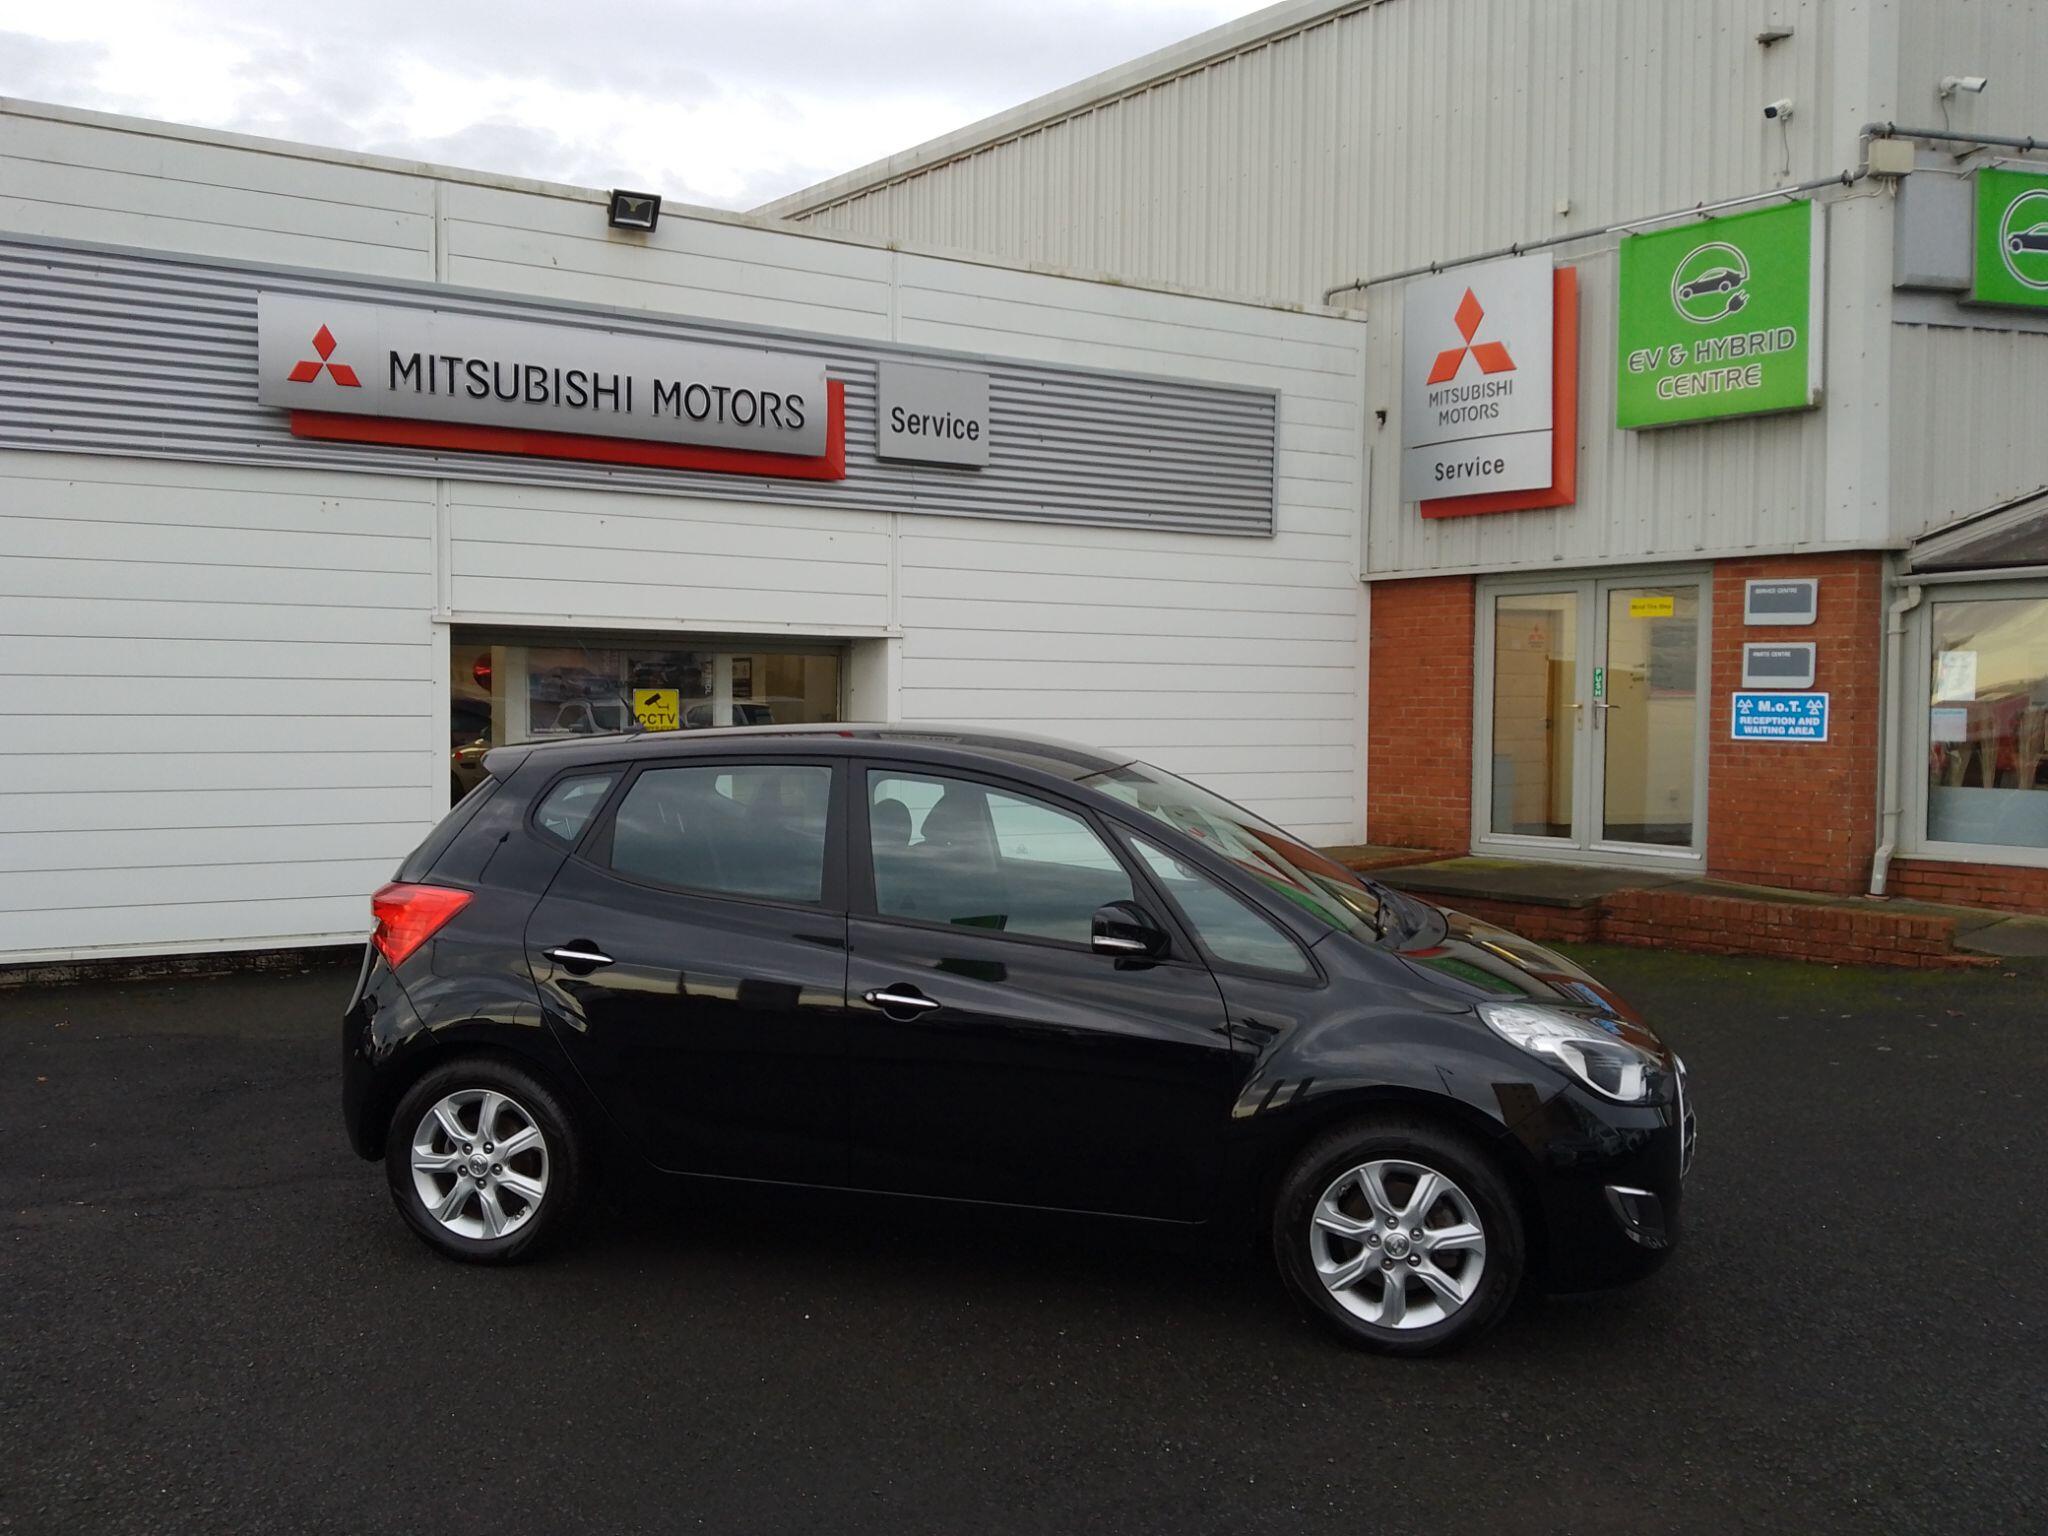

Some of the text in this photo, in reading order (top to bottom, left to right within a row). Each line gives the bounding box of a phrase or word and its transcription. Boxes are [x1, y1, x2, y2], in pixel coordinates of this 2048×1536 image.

[1628, 326, 1797, 373] EV & HYBRID
[388, 350, 805, 430] MITSUBISHI MOTORS
[1428, 379, 1513, 408] MITSUBISHI
[1656, 363, 1762, 400] CENTRE
[891, 406, 980, 441] Service
[1438, 402, 1500, 426] MOTORS
[1434, 456, 1505, 481] Service
[1757, 700, 1802, 712] M.o.T.
[637, 713, 676, 725] CCTV
[1739, 716, 1821, 726] RECEPTION AND
[1743, 725, 1816, 735] WAITING AREA
